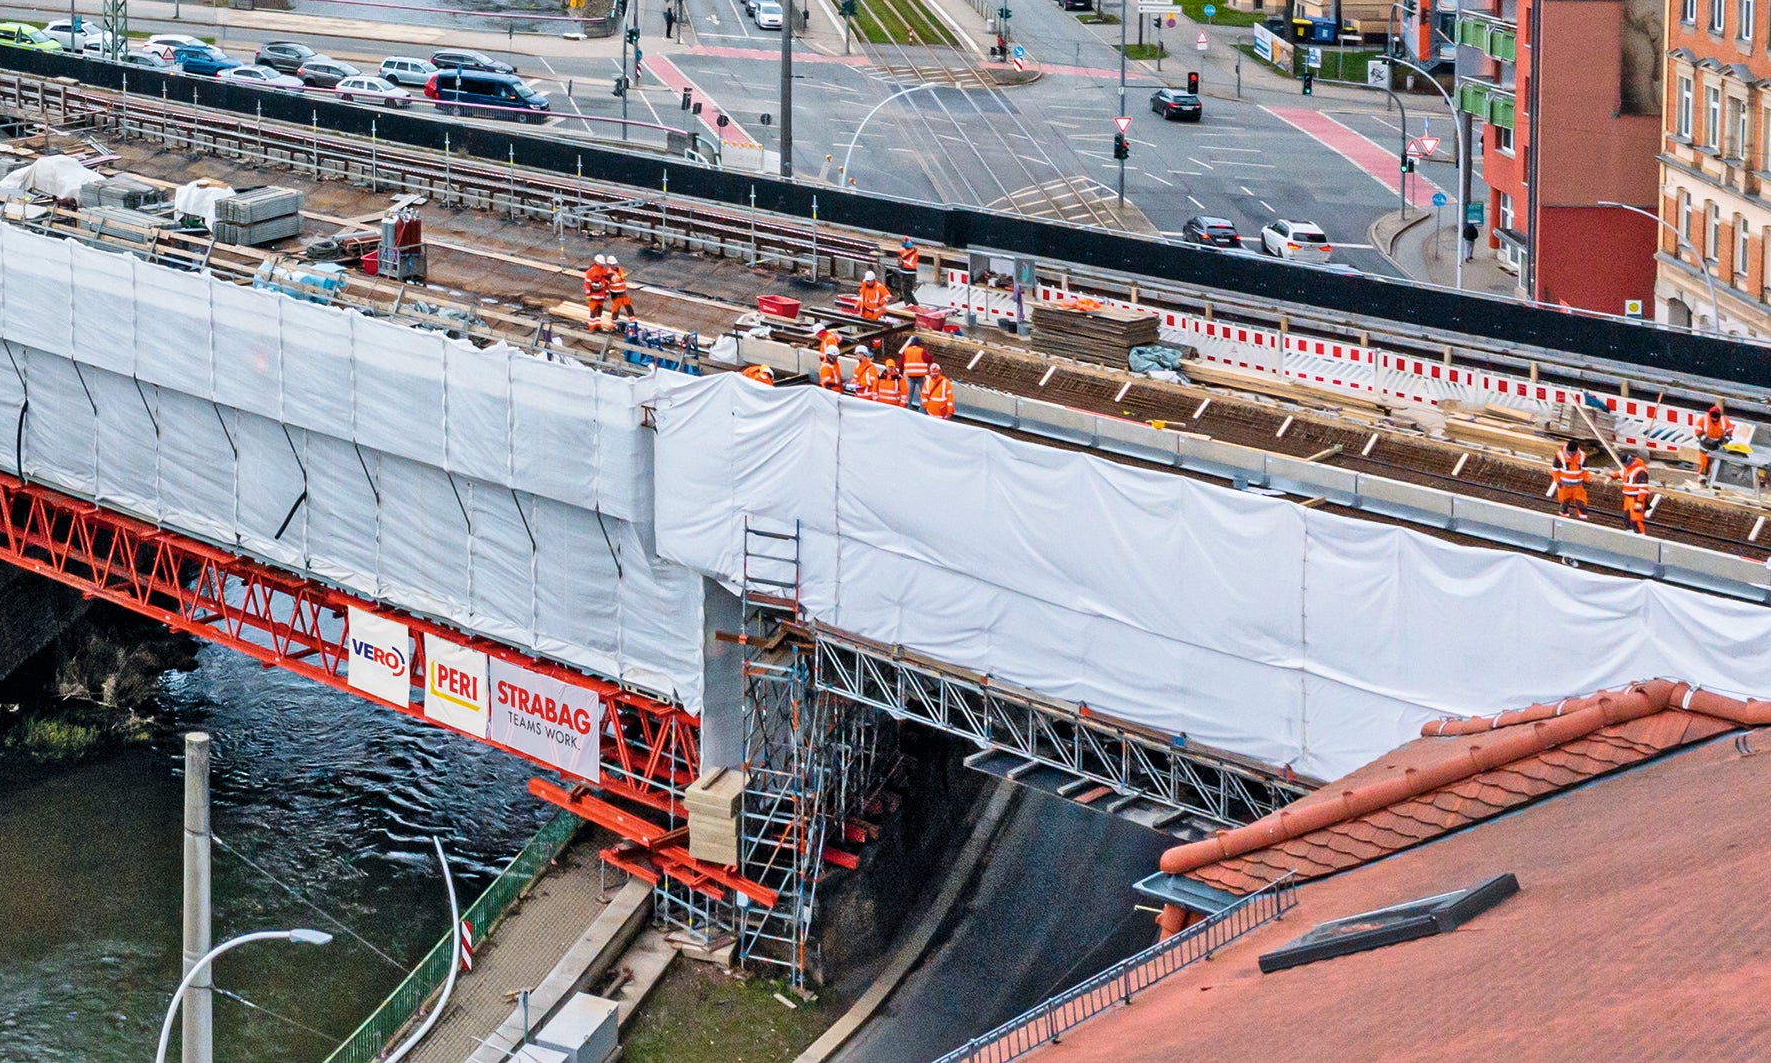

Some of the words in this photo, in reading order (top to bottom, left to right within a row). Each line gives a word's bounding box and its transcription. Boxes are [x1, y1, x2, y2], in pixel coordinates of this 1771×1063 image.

[352, 638, 399, 670] VERO
[437, 663, 478, 702] PERI
[497, 680, 591, 735] STRABAG
[508, 711, 542, 736] TEAMS
[545, 725, 581, 751] WORK.
